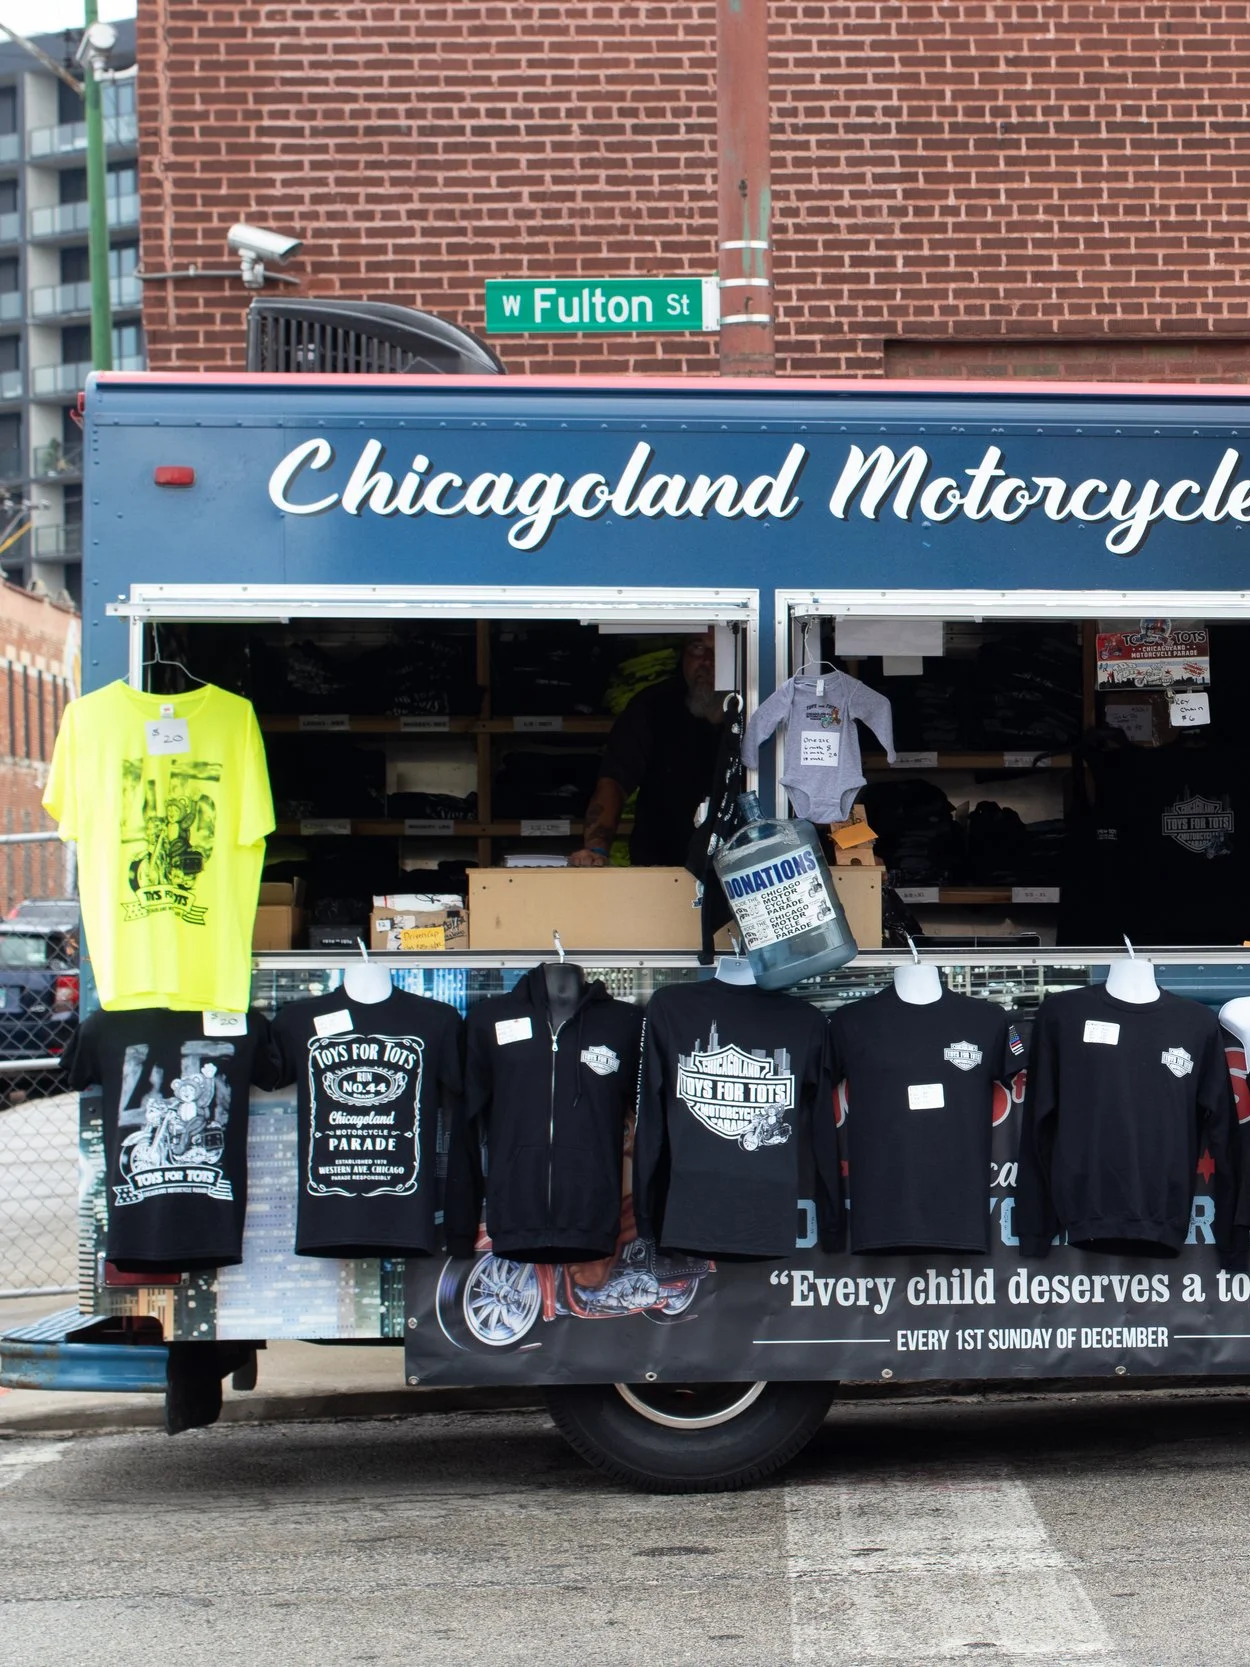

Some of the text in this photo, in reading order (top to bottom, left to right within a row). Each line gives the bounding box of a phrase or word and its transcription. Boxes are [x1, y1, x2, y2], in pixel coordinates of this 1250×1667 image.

[502, 288, 690, 323] W Fulton St
[268, 438, 805, 551] Chicagoland
[1174, 631, 1206, 642] TOTS
[163, 735, 184, 743] 20
[1166, 816, 1229, 830] TOYS FOR TOTS
[724, 850, 817, 900] DONATIONS
[761, 880, 800, 900] CHICAGO
[762, 888, 799, 905] MOTOR
[765, 897, 793, 910] CYCLE
[767, 898, 804, 916] PARADE
[769, 904, 809, 923] CHICAGO
[771, 911, 807, 929] MOTOR
[773, 920, 800, 935] CYCLE
[775, 921, 813, 940] PARADE
[220, 1018, 238, 1026] 20
[313, 1042, 417, 1069] TOYS FOR TOTS
[702, 1053, 761, 1078] CHICAGOLAND
[357, 1072, 373, 1082] RUN
[717, 1081, 744, 1102] FOR
[749, 1084, 786, 1104] TOTS
[329, 1111, 395, 1128] Chicagoland
[329, 1138, 396, 1150] PARADE
[134, 1169, 215, 1187] TOYS FOR TOTS
[319, 1165, 405, 1175] WESTERN AVE. CHICAGO
[770, 1269, 895, 1314] “Every
[906, 1268, 996, 1306] child
[1008, 1268, 1170, 1304] deserves
[1182, 1277, 1206, 1303] a
[897, 1327, 1169, 1351] EVERY 1ST SUNDAY OF DECEMBER
